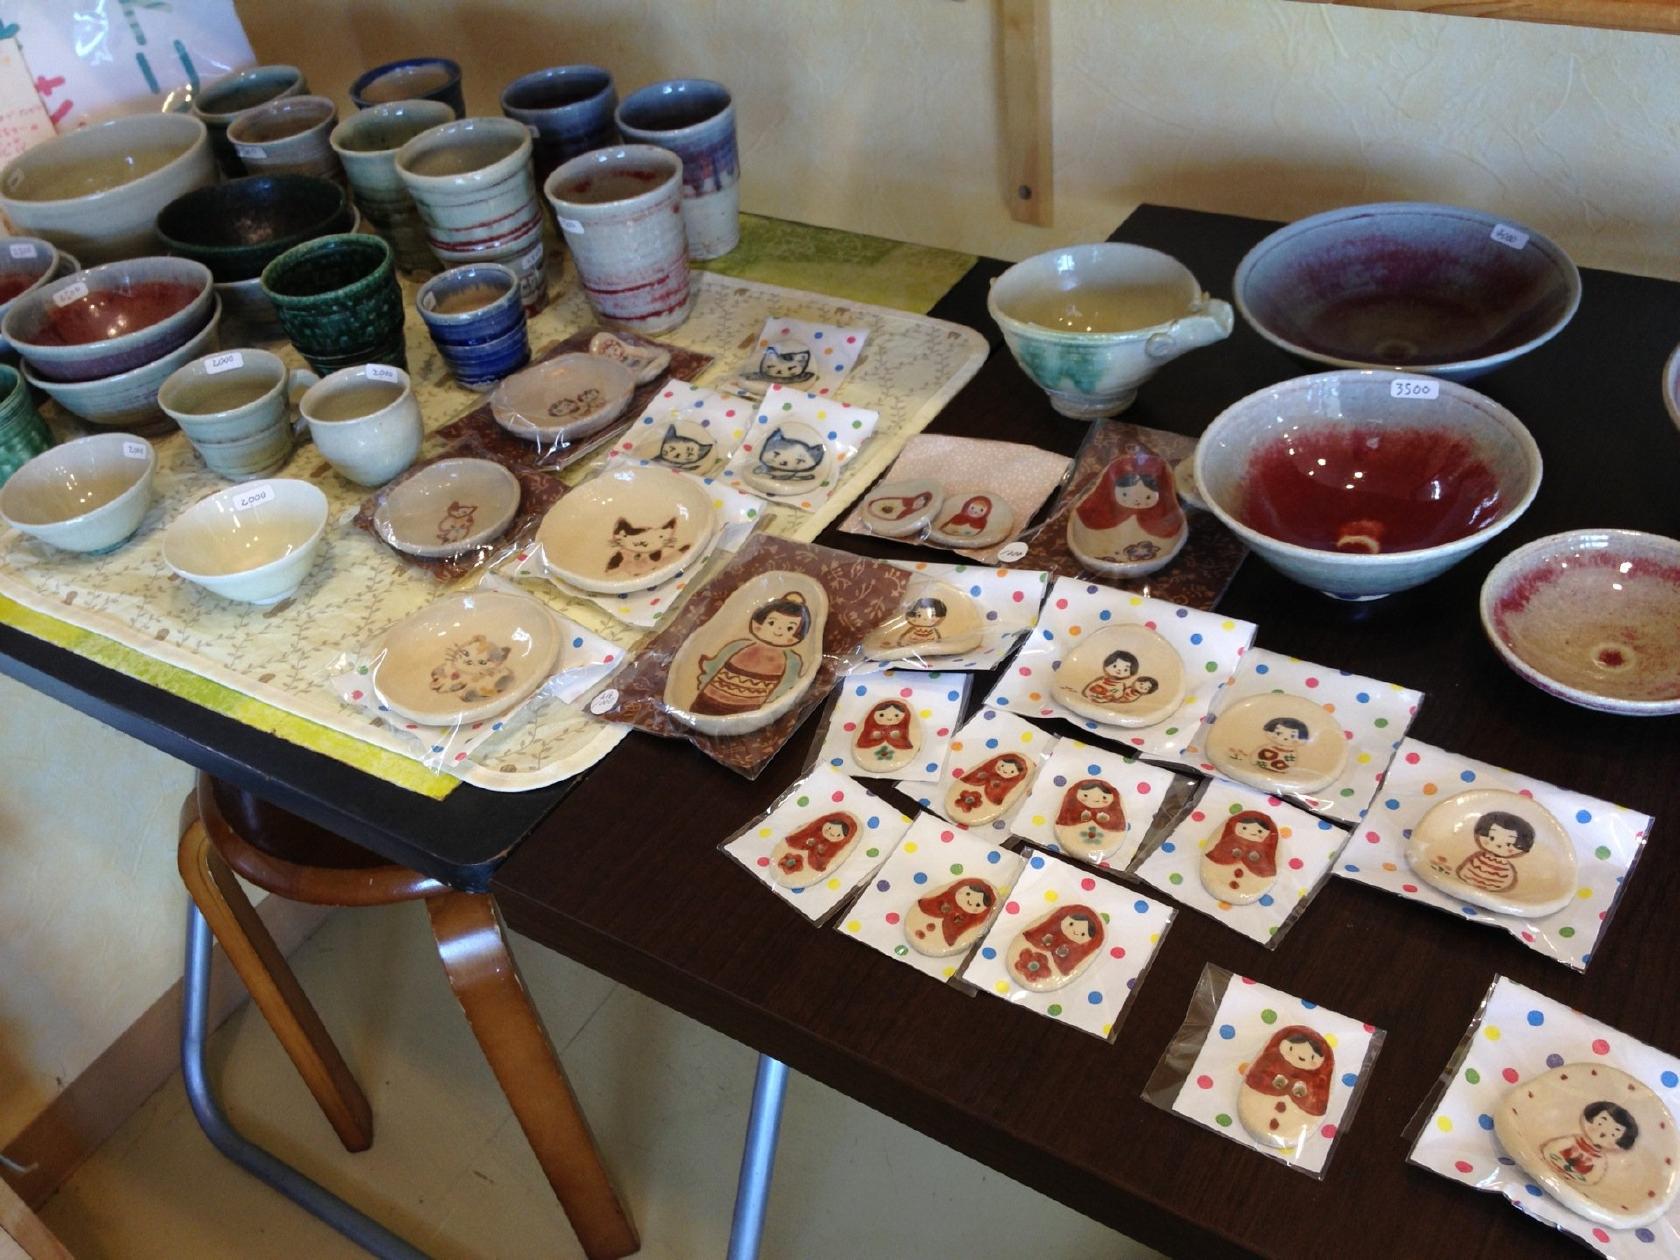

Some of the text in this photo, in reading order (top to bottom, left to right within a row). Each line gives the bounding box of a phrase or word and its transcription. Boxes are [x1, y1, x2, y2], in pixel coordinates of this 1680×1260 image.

[212, 355, 235, 368] 2000
[372, 368, 394, 378] 2000
[1395, 382, 1431, 396] 3500
[241, 490, 267, 506] 2000
